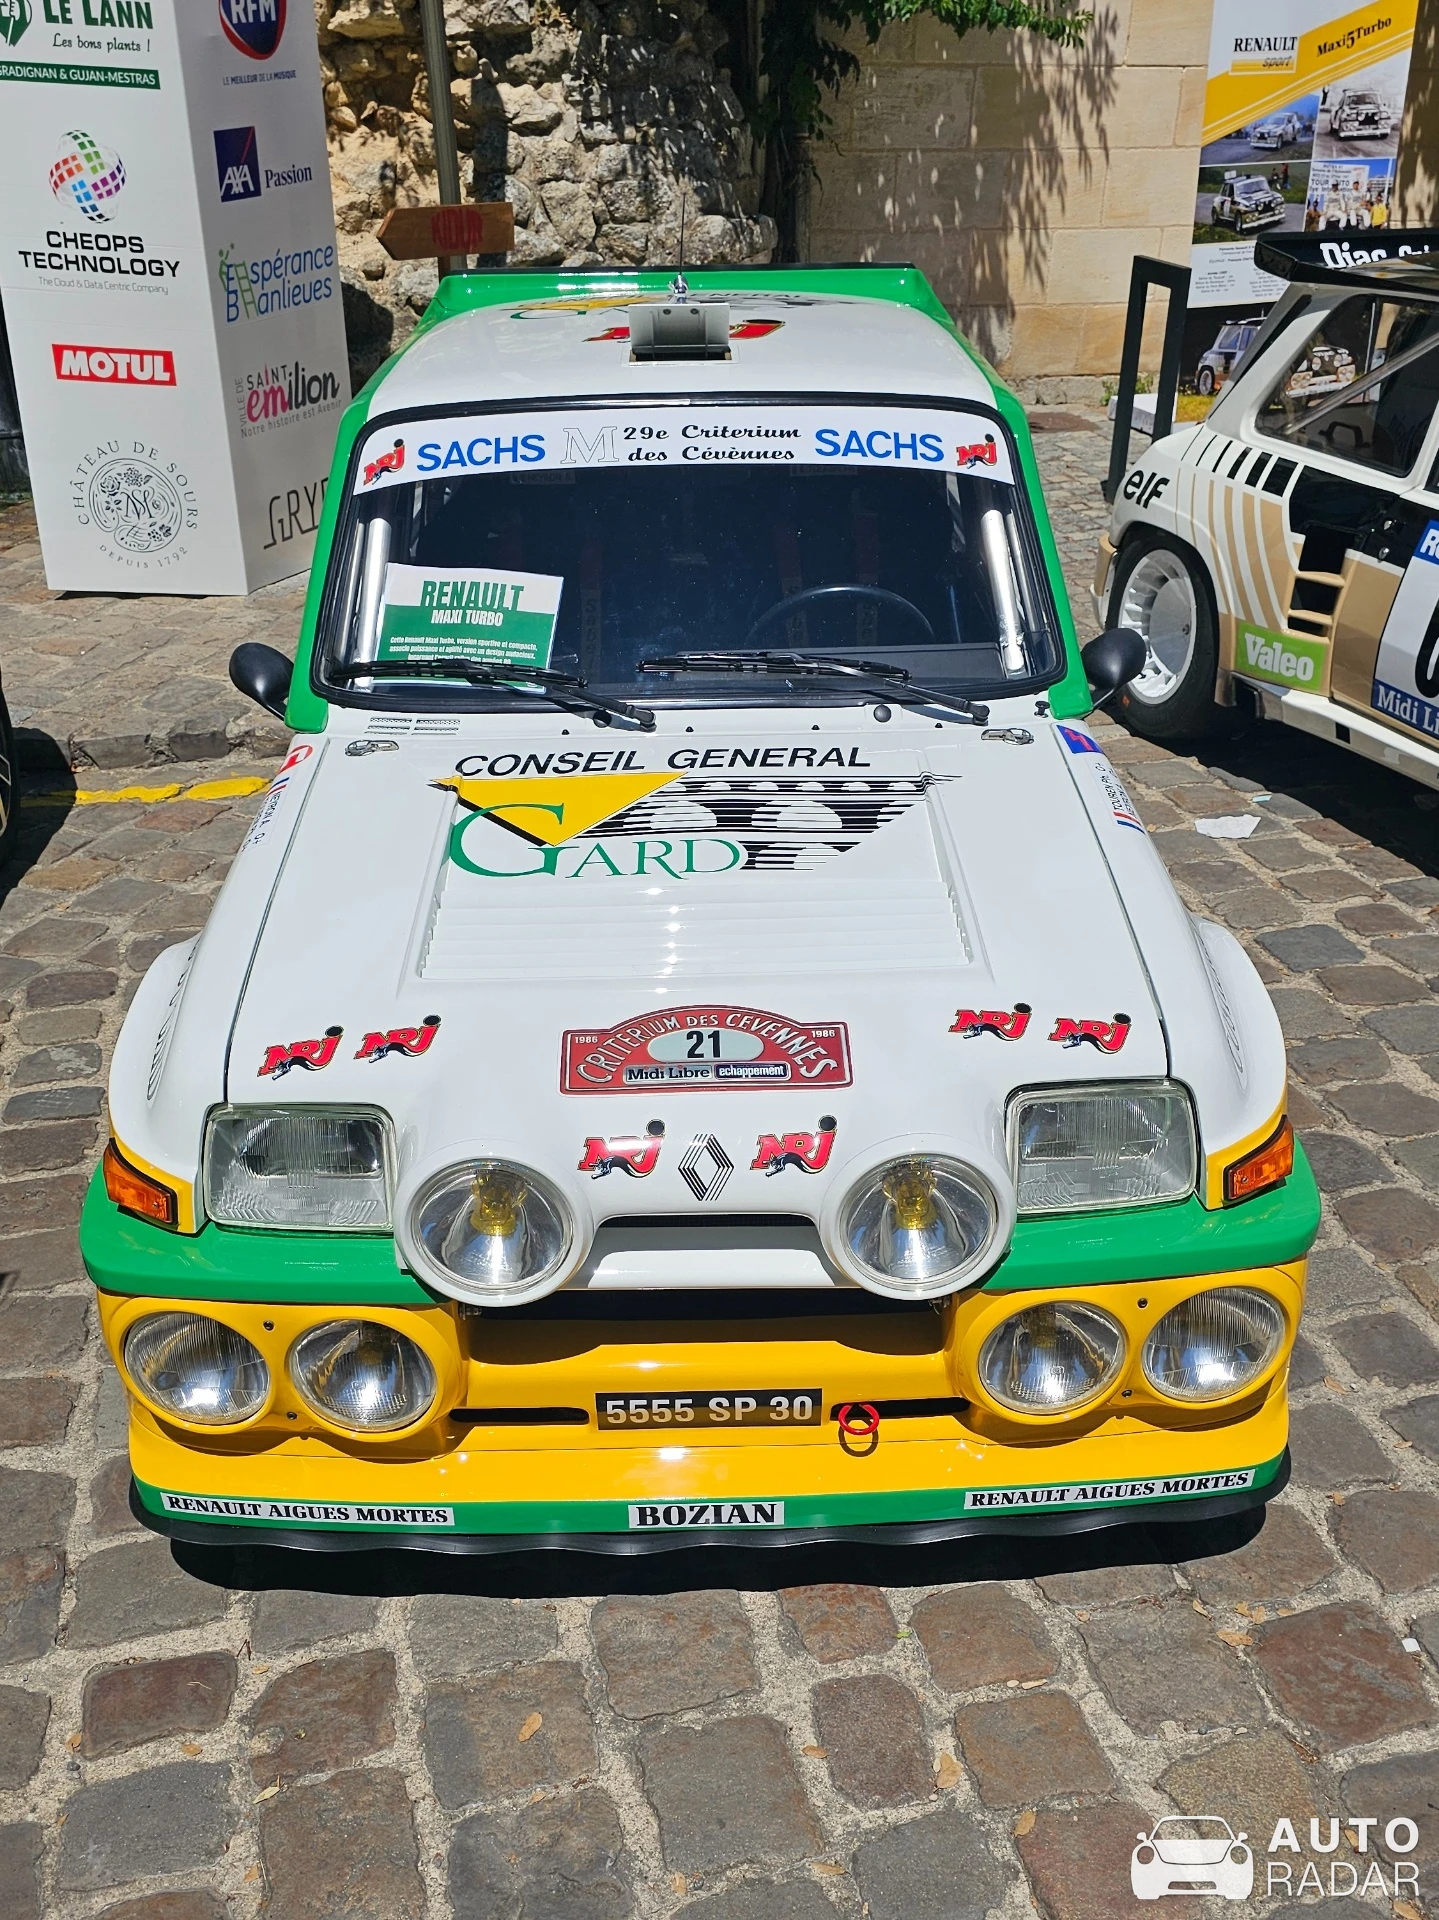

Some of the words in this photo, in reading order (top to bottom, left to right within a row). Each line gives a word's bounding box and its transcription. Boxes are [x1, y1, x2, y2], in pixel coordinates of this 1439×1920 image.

[42, 0, 73, 24] LE
[82, 0, 153, 29] LANN
[230, 0, 276, 24] RFM
[53, 33, 73, 48] Les
[77, 35, 102, 50] bons
[107, 37, 141, 53] plants
[1233, 36, 1298, 52] RENAULT
[59, 69, 68, 80] &
[69, 69, 156, 86] GUJAN-MESTRAS
[223, 76, 230, 85] LE
[231, 74, 258, 85] MEILLEUR
[259, 73, 265, 82] DE
[266, 72, 273, 81] LA
[274, 69, 297, 80] MUSIQUE
[1262, 56, 1292, 69] sport
[220, 164, 255, 196] AXA
[265, 164, 313, 188] Passion
[46, 230, 144, 253] CHEOPS
[18, 250, 180, 277] TECHNOLOGY
[39, 276, 53, 286] The
[76, 280, 83, 288] &
[84, 279, 103, 290] Data
[104, 281, 131, 291] Centric
[131, 283, 169, 295] Company
[60, 349, 171, 381] MOTUL
[246, 363, 288, 391] SAINT
[246, 361, 340, 423] emilion
[241, 425, 265, 438] Notre
[268, 413, 300, 430] histoire
[303, 407, 315, 419] est
[318, 400, 342, 414] Avenir
[623, 426, 670, 441] 29e
[681, 424, 802, 439] Criterium
[416, 434, 546, 472] SACHS
[560, 426, 620, 465] M
[628, 447, 668, 461] des
[681, 446, 795, 461] Cévènnes
[815, 428, 945, 462] SACHS
[956, 434, 998, 469] NRJ
[363, 438, 405, 485] NRJ
[70, 440, 120, 525] CHÂTEAU
[133, 441, 158, 460] DE
[166, 463, 198, 530] SOURS
[1123, 469, 1172, 509] elf
[99, 545, 149, 569] DEPUIS
[157, 546, 188, 567] 1792
[420, 580, 524, 611] RENAULT
[431, 609, 462, 624] MAXI
[465, 611, 504, 627] TURBO
[1244, 633, 1314, 682] Valeo
[1377, 685, 1419, 725] Midi
[455, 750, 643, 777] CONSEIL
[667, 746, 872, 769] GENERAL
[449, 803, 740, 879] GARD
[811, 1029, 835, 1038] 1986
[948, 1002, 1032, 1041] NRJ
[1047, 1013, 1131, 1054] NRJ
[257, 1025, 344, 1081] NRJ
[354, 1015, 441, 1063] NRJ
[575, 1035, 598, 1044] 1986
[576, 1015, 680, 1083] CRITERIUM
[686, 1015, 719, 1027] DES
[725, 1013, 838, 1078] CEVENNES
[686, 1030, 721, 1058] 21
[628, 1065, 665, 1080] Midi
[668, 1065, 710, 1079] Libre
[719, 1065, 784, 1078] echappement
[577, 1119, 665, 1180] NRJ
[750, 1115, 837, 1178] NRJ
[606, 1399, 695, 1424] 5555
[708, 1396, 757, 1422] SP
[769, 1395, 813, 1420] 30
[970, 1489, 1070, 1506] RENAULT
[1073, 1482, 1155, 1501] AIGUES
[1160, 1472, 1249, 1493] MORTES
[166, 1495, 262, 1517] RENAULT
[269, 1504, 350, 1521] AIGUES
[356, 1508, 448, 1523] MORTES
[636, 1503, 777, 1526] BOZIAN
